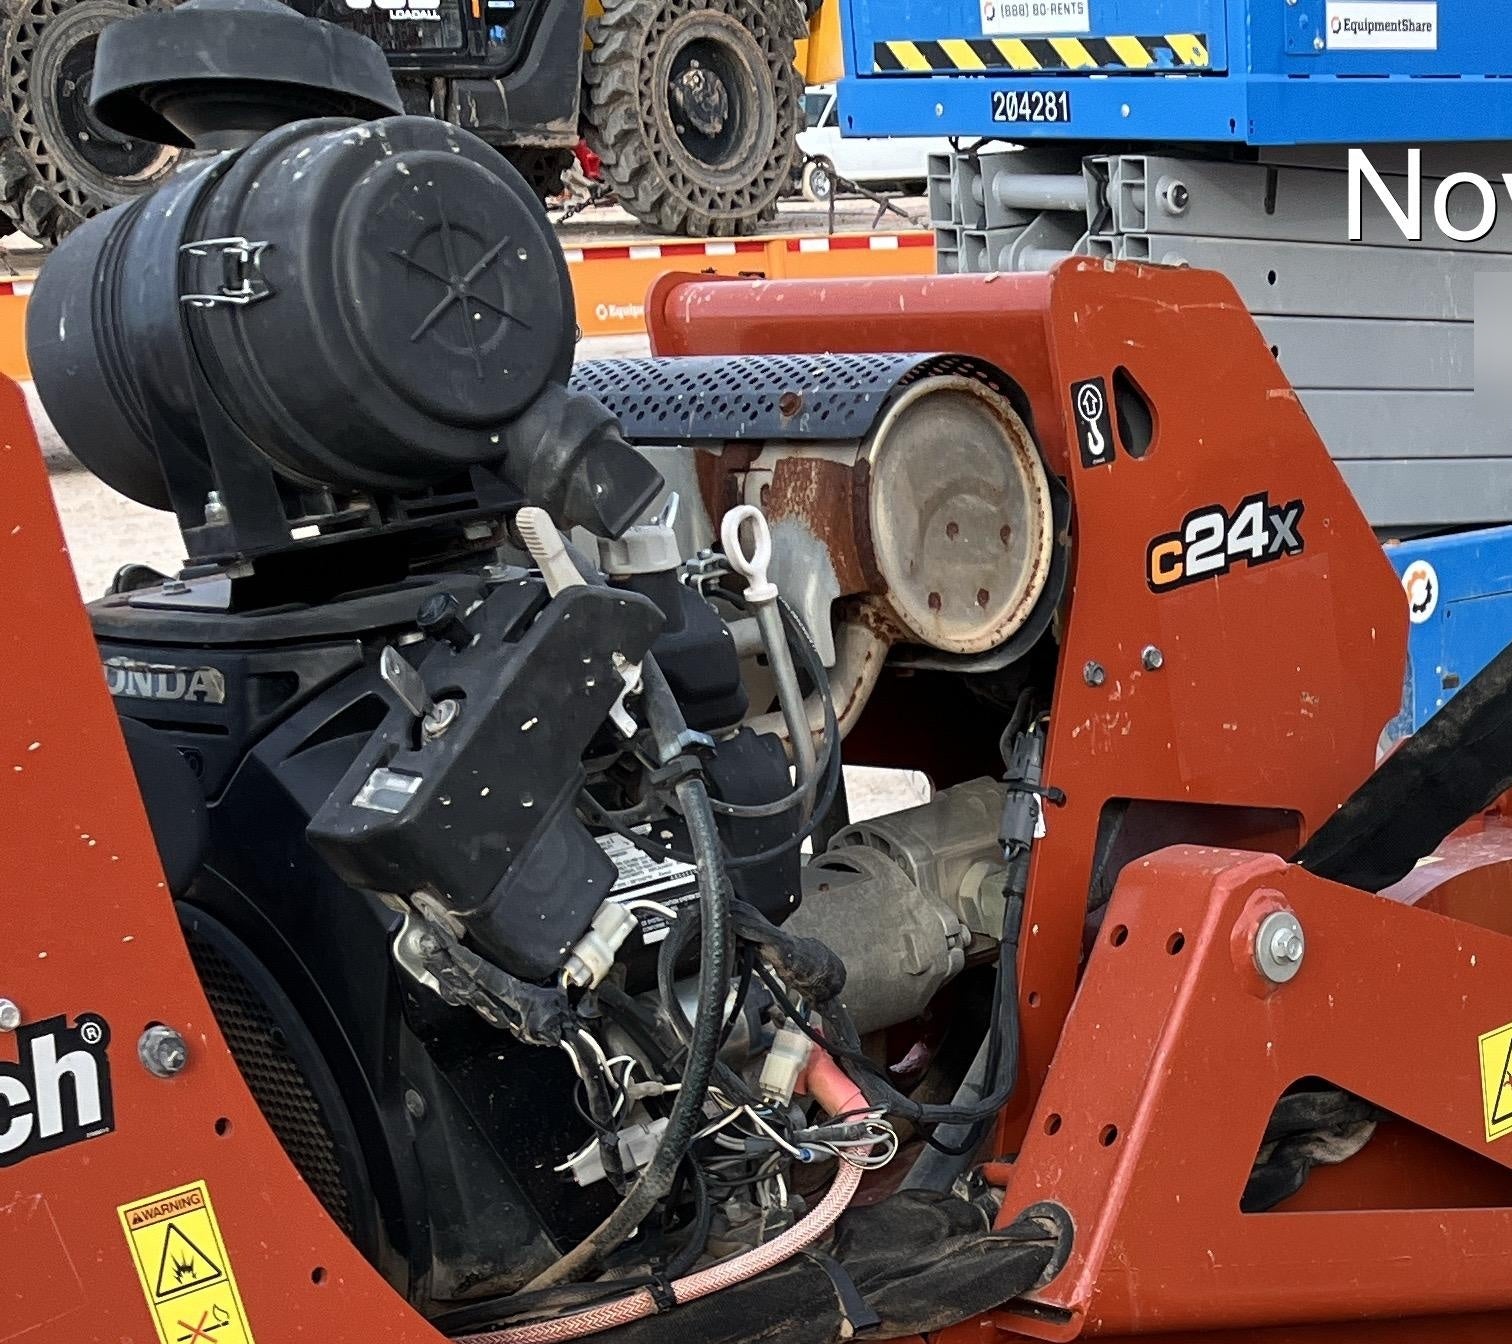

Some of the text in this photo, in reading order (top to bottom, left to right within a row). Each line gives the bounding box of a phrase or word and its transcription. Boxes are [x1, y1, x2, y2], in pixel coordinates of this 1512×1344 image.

[389, 9, 441, 20] LOADALL
[1343, 17, 1433, 35] EquipmentShare
[993, 90, 1069, 122] 204281
[103, 665, 222, 703] ONDA
[140, 1193, 201, 1220] WARNING
